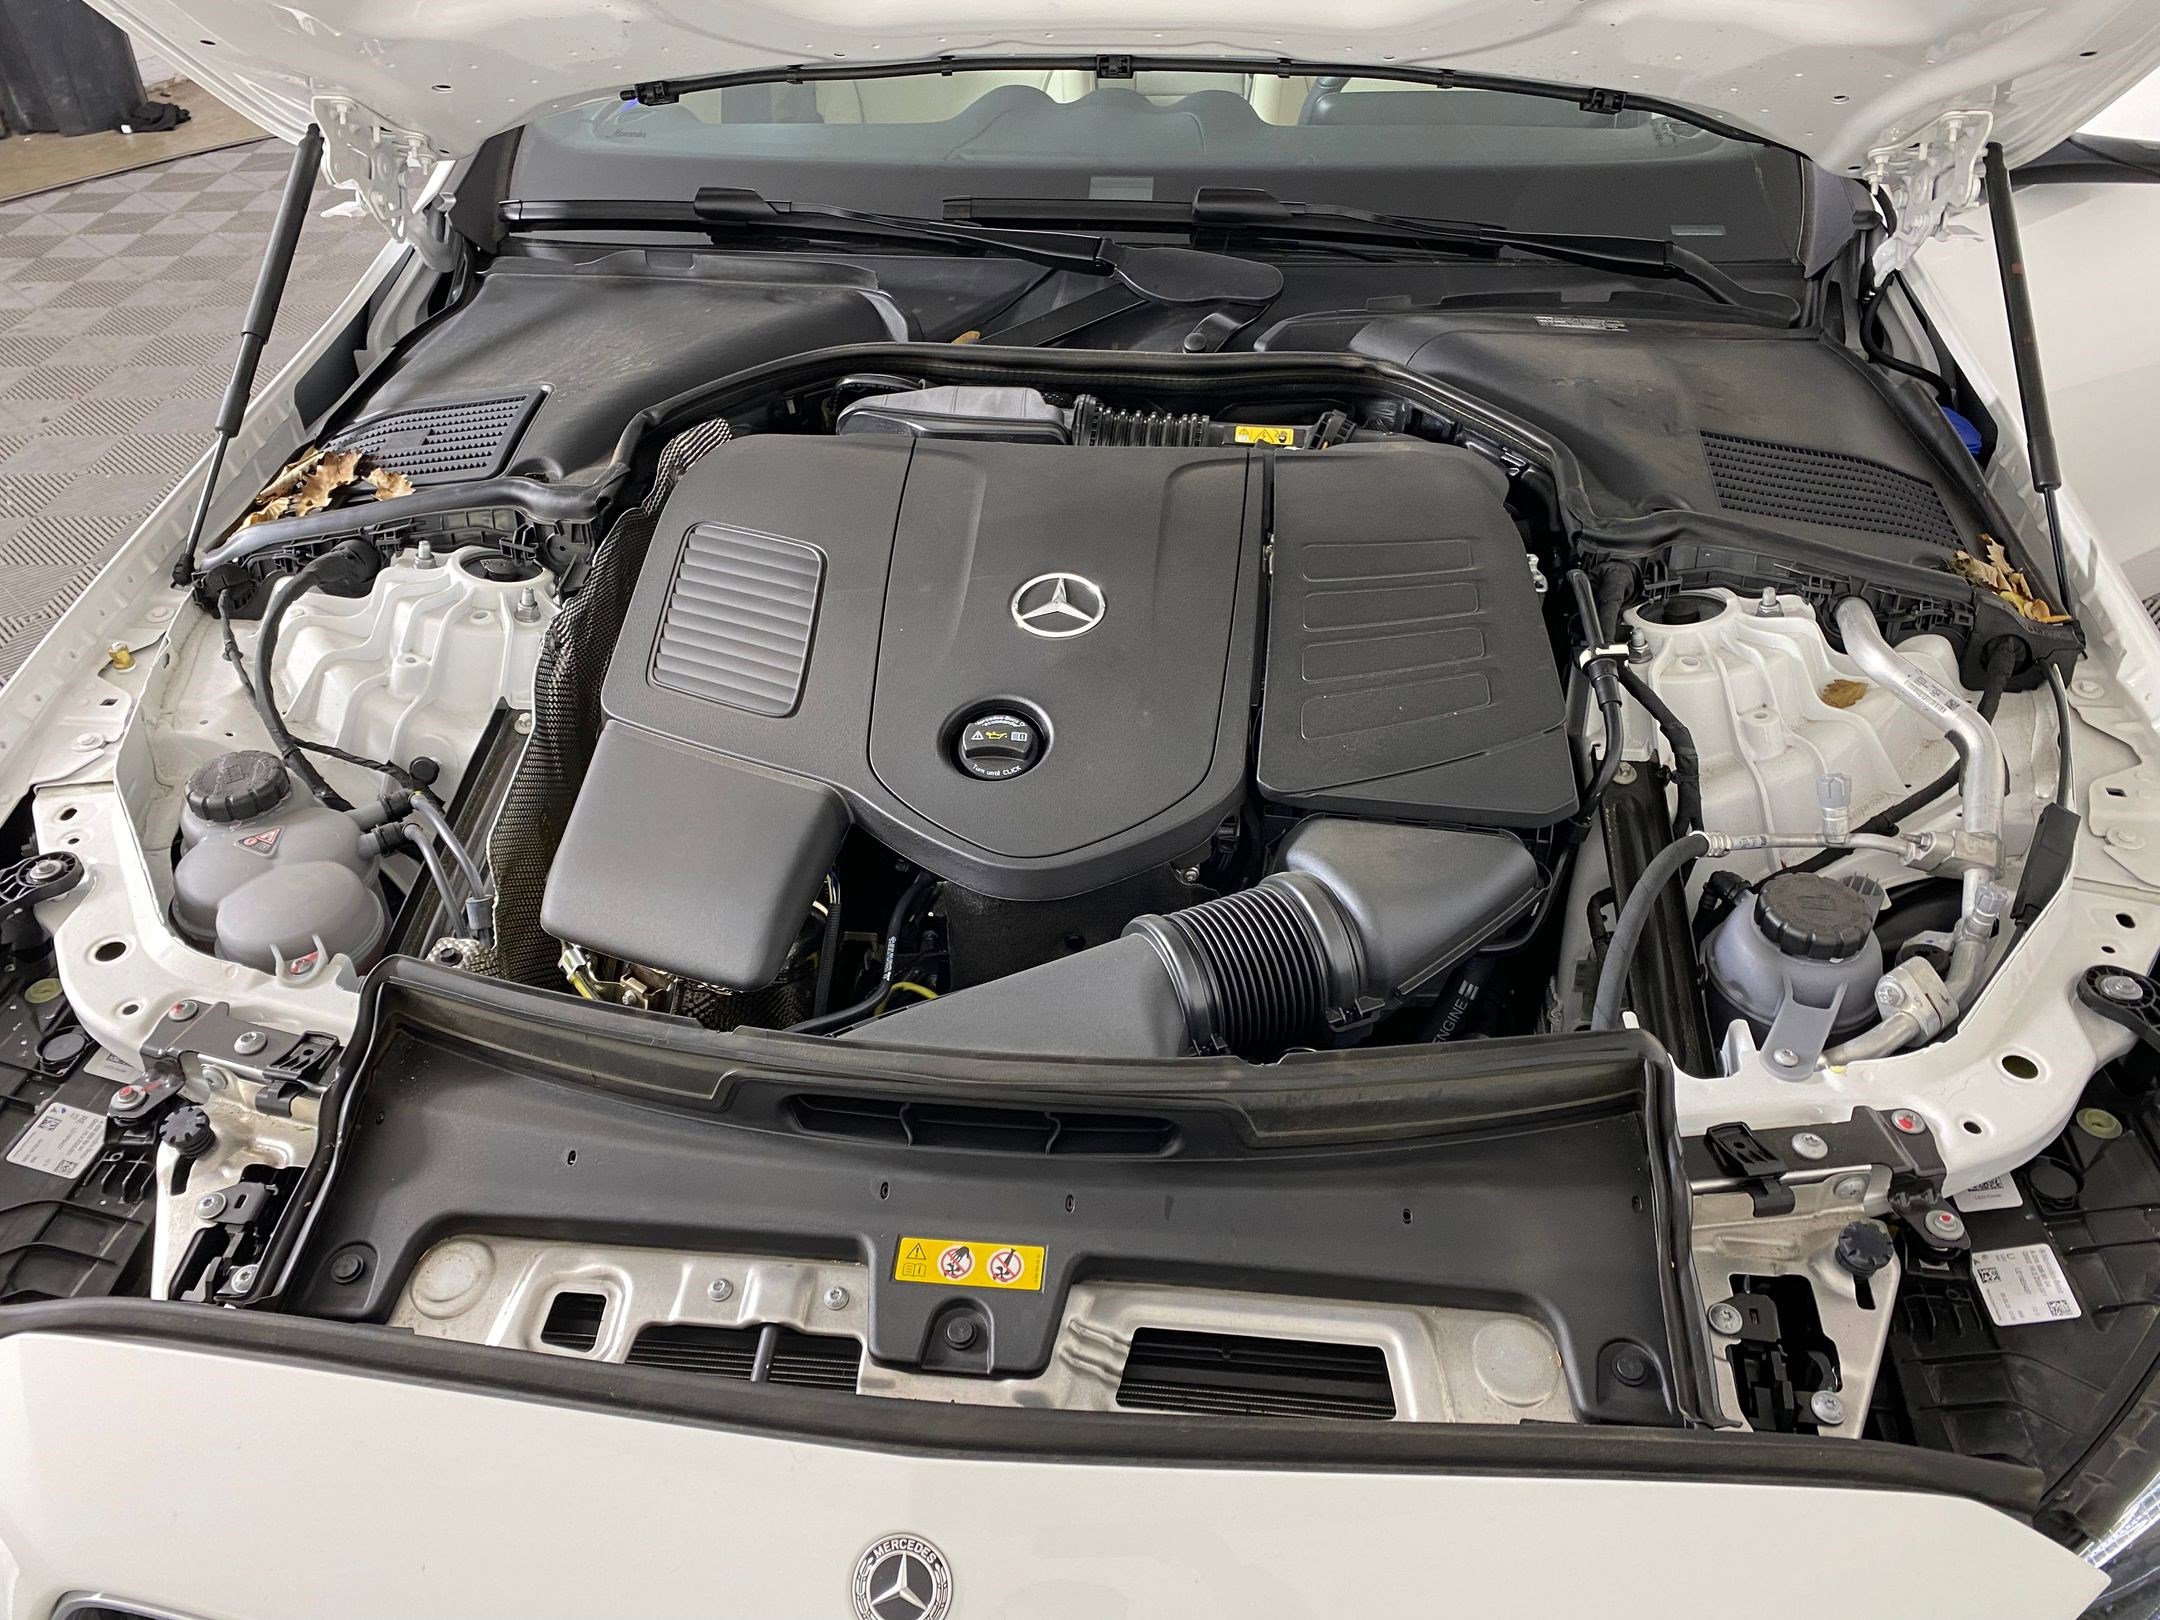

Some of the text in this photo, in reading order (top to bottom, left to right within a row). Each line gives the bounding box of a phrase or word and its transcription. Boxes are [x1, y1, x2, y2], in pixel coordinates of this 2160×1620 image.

[972, 763, 985, 774] Turn
[1002, 765, 1022, 776] CLICK
[873, 1538, 937, 1564] MERCEDES
